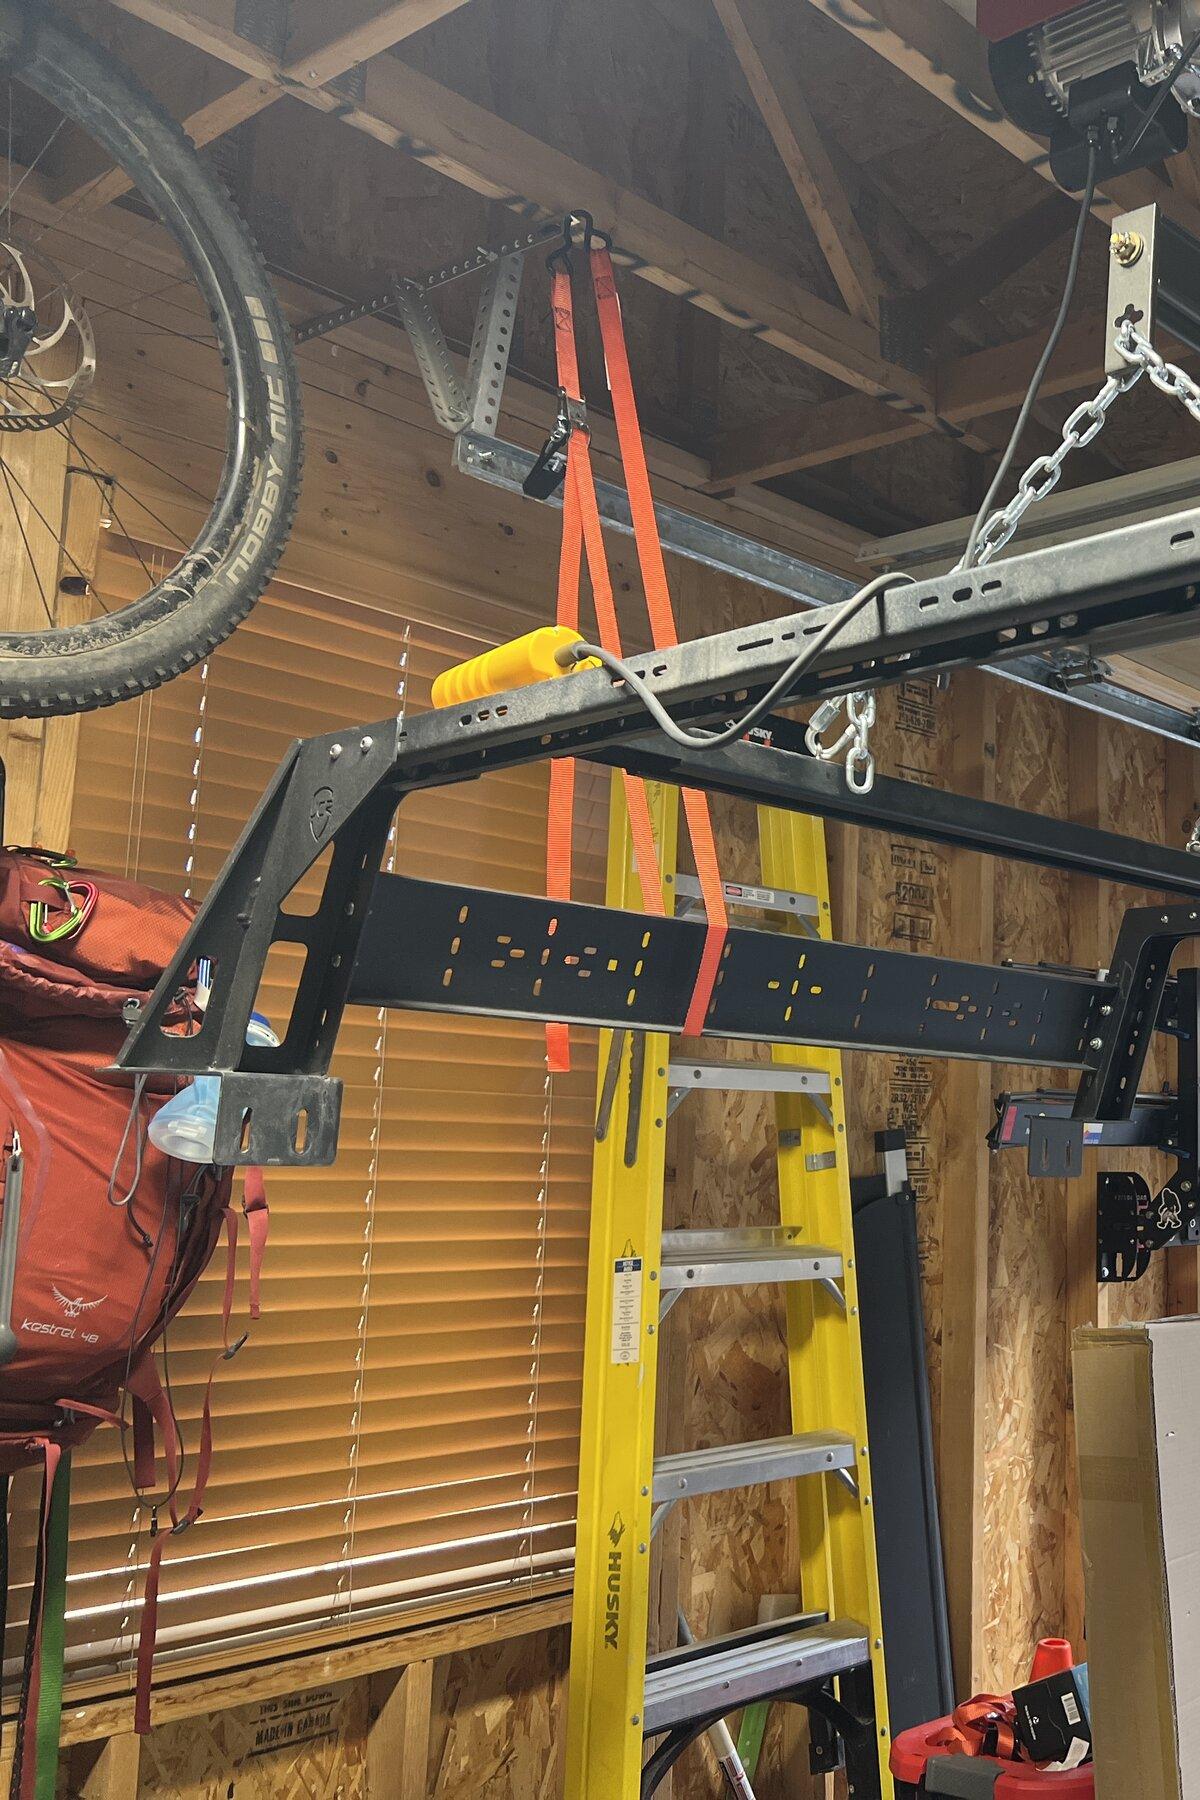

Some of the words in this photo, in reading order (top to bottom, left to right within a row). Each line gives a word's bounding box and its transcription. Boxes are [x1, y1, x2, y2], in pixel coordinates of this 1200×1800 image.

[225, 453, 284, 585] NOBBY
[266, 374, 287, 443] NIC
[748, 727, 773, 740] SKY
[21, 1318, 76, 1339] kestrel
[81, 1331, 100, 1343] 48
[604, 1551, 622, 1650] HUSKY
